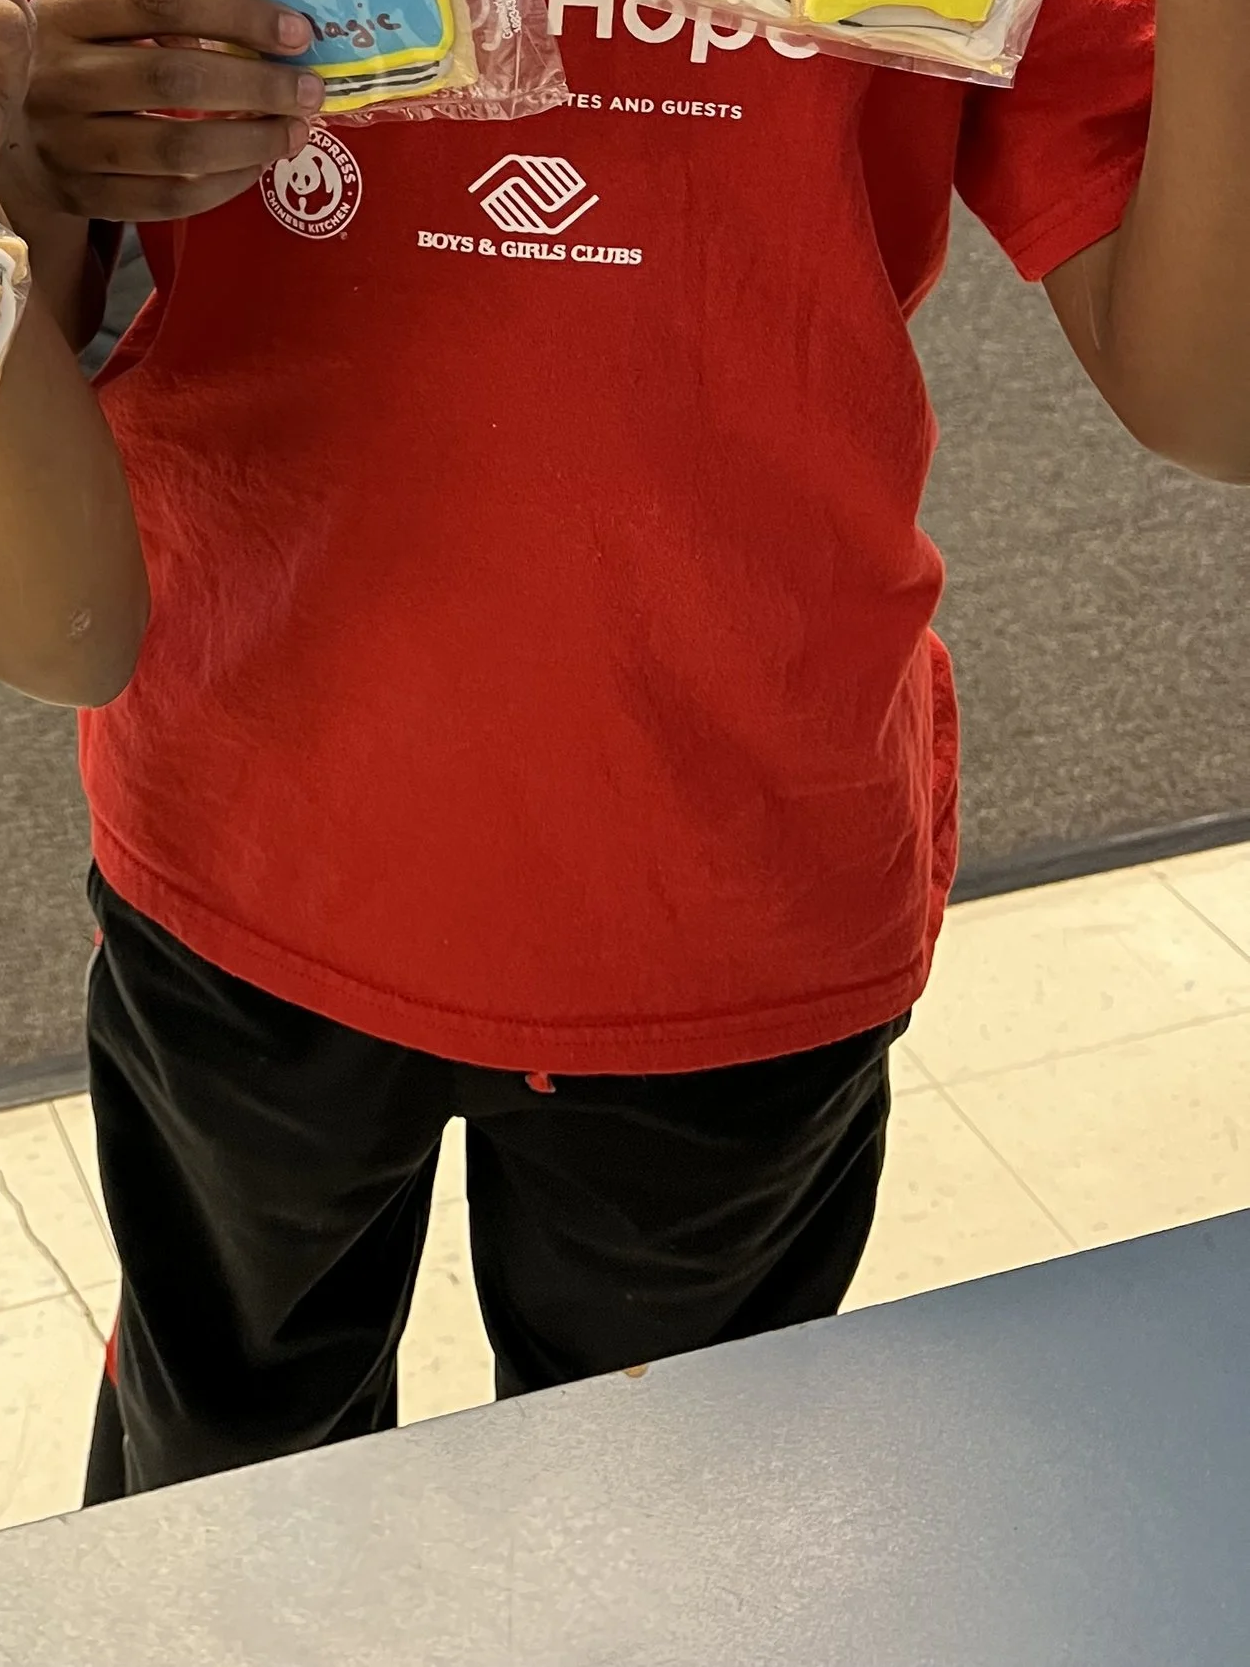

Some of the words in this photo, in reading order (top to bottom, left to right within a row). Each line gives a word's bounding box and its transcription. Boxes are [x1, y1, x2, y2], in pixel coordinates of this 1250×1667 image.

[301, 3, 402, 48] agic
[609, 96, 655, 114] AND
[661, 100, 743, 121] GUESTS
[266, 189, 306, 232] CHINESE
[308, 201, 352, 233] KITCHEN
[416, 230, 474, 254] BOYS
[477, 238, 498, 256] &
[500, 240, 567, 261] GIRLS
[570, 244, 643, 266] CLUBS
